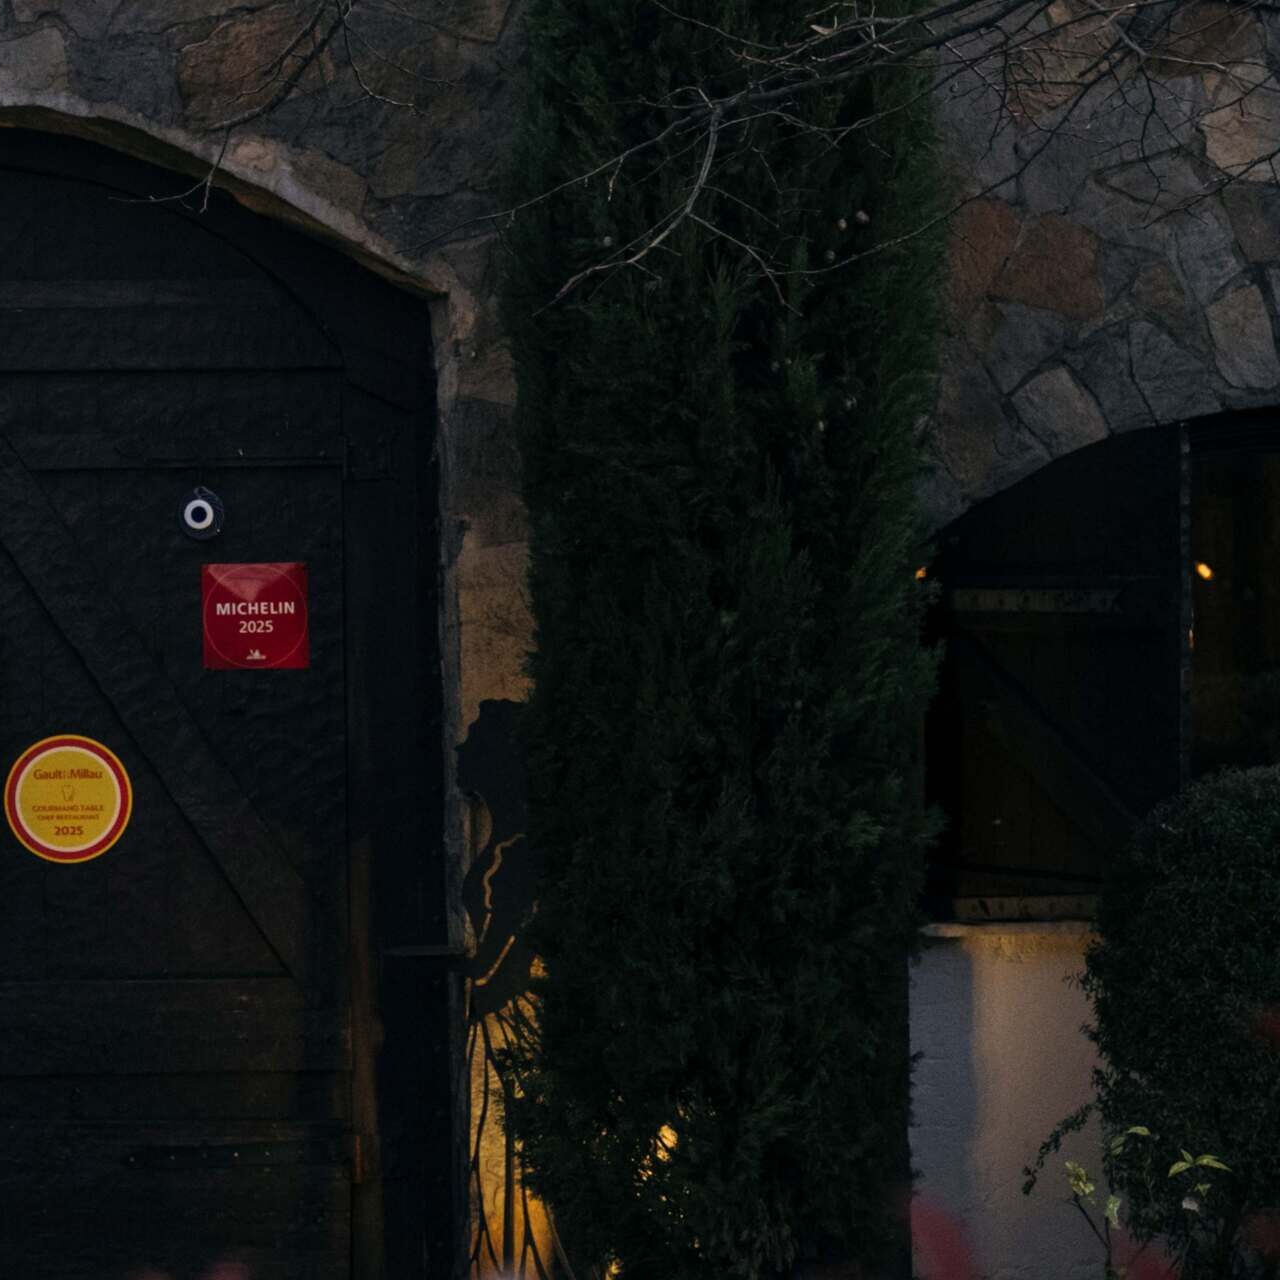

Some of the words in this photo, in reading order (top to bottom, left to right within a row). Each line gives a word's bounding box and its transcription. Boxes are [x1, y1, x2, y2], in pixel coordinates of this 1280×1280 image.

[216, 601, 295, 616] MICHELIN
[239, 620, 274, 634] 2025
[53, 825, 84, 836] 2025
